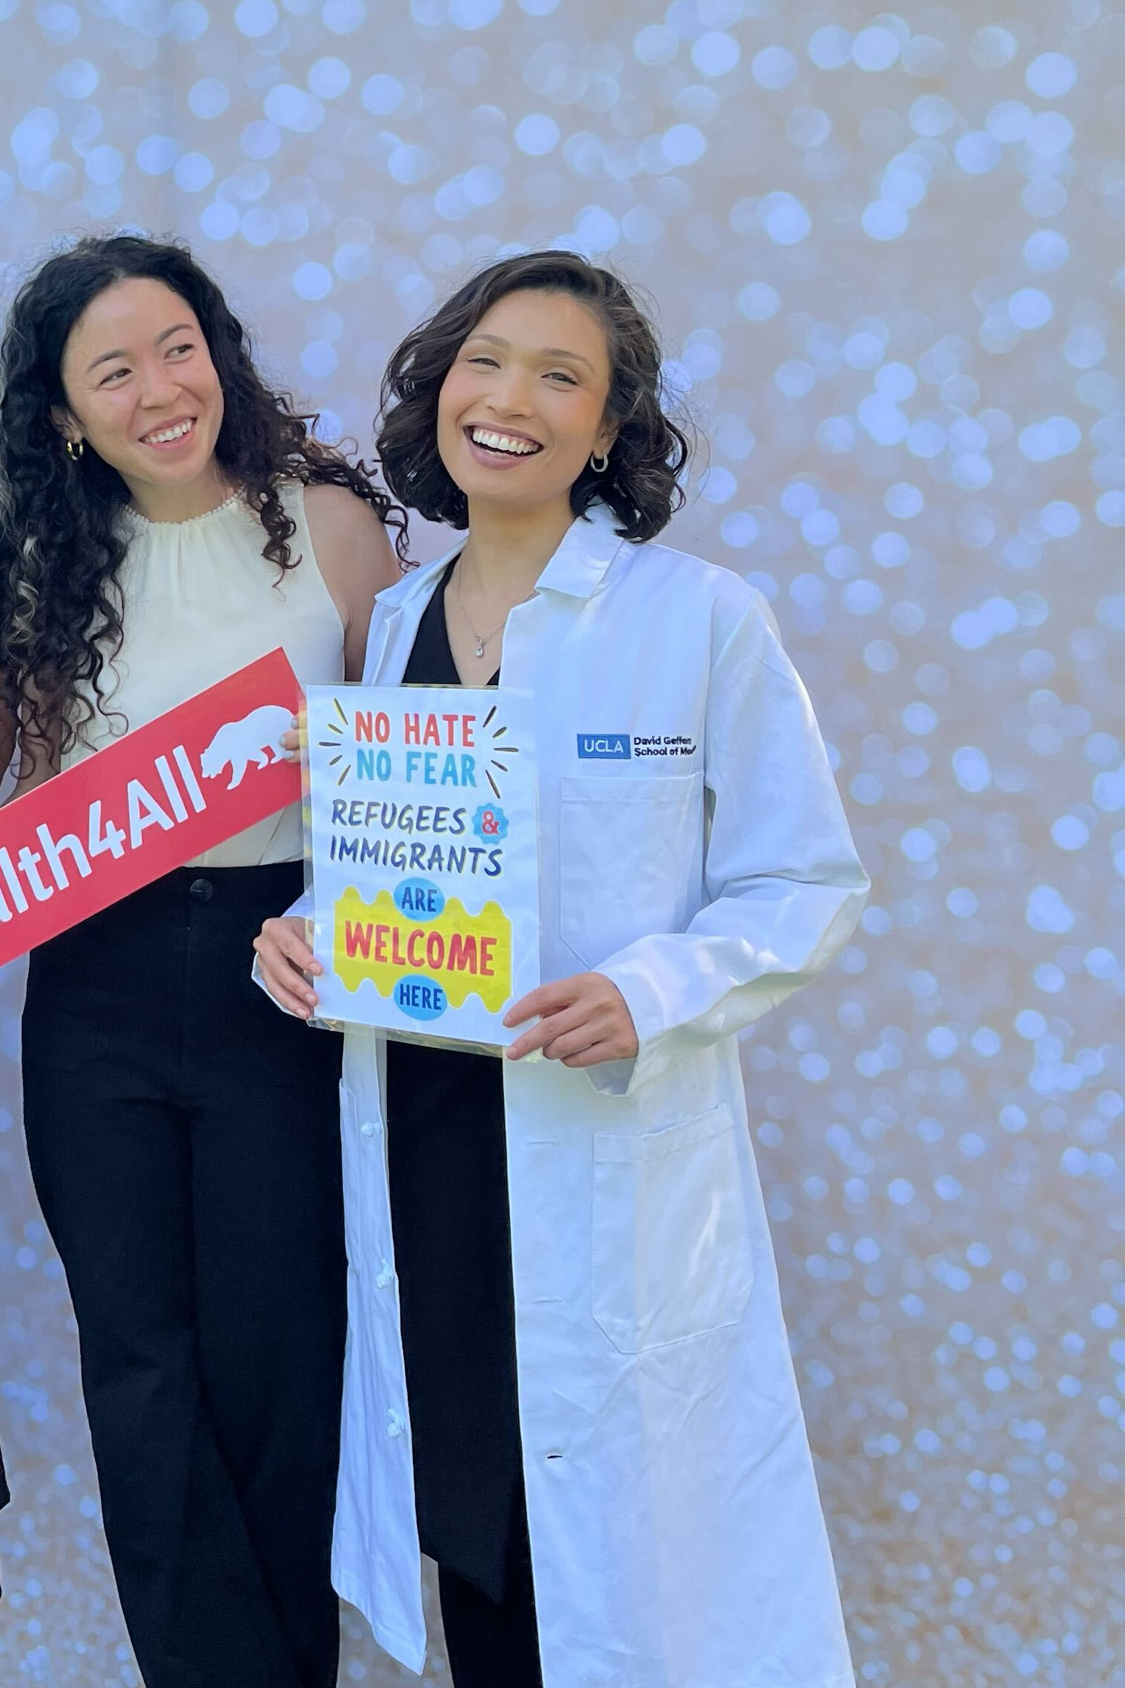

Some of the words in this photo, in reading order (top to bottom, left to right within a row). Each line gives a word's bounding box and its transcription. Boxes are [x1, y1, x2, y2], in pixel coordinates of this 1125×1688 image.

[355, 710, 391, 743] NO
[404, 713, 477, 748] HATE
[634, 736, 661, 746] David
[584, 739, 624, 753] UCLA
[634, 747, 668, 757] School
[670, 747, 679, 756] of
[357, 748, 392, 781] NO
[406, 751, 477, 787] FEAR
[331, 798, 467, 835] REFUGEES
[481, 810, 500, 835] &
[329, 834, 504, 877] IMMIGRANTS
[401, 886, 438, 912] ARE
[345, 920, 497, 976] WELCOME
[399, 983, 443, 1011] HERE
